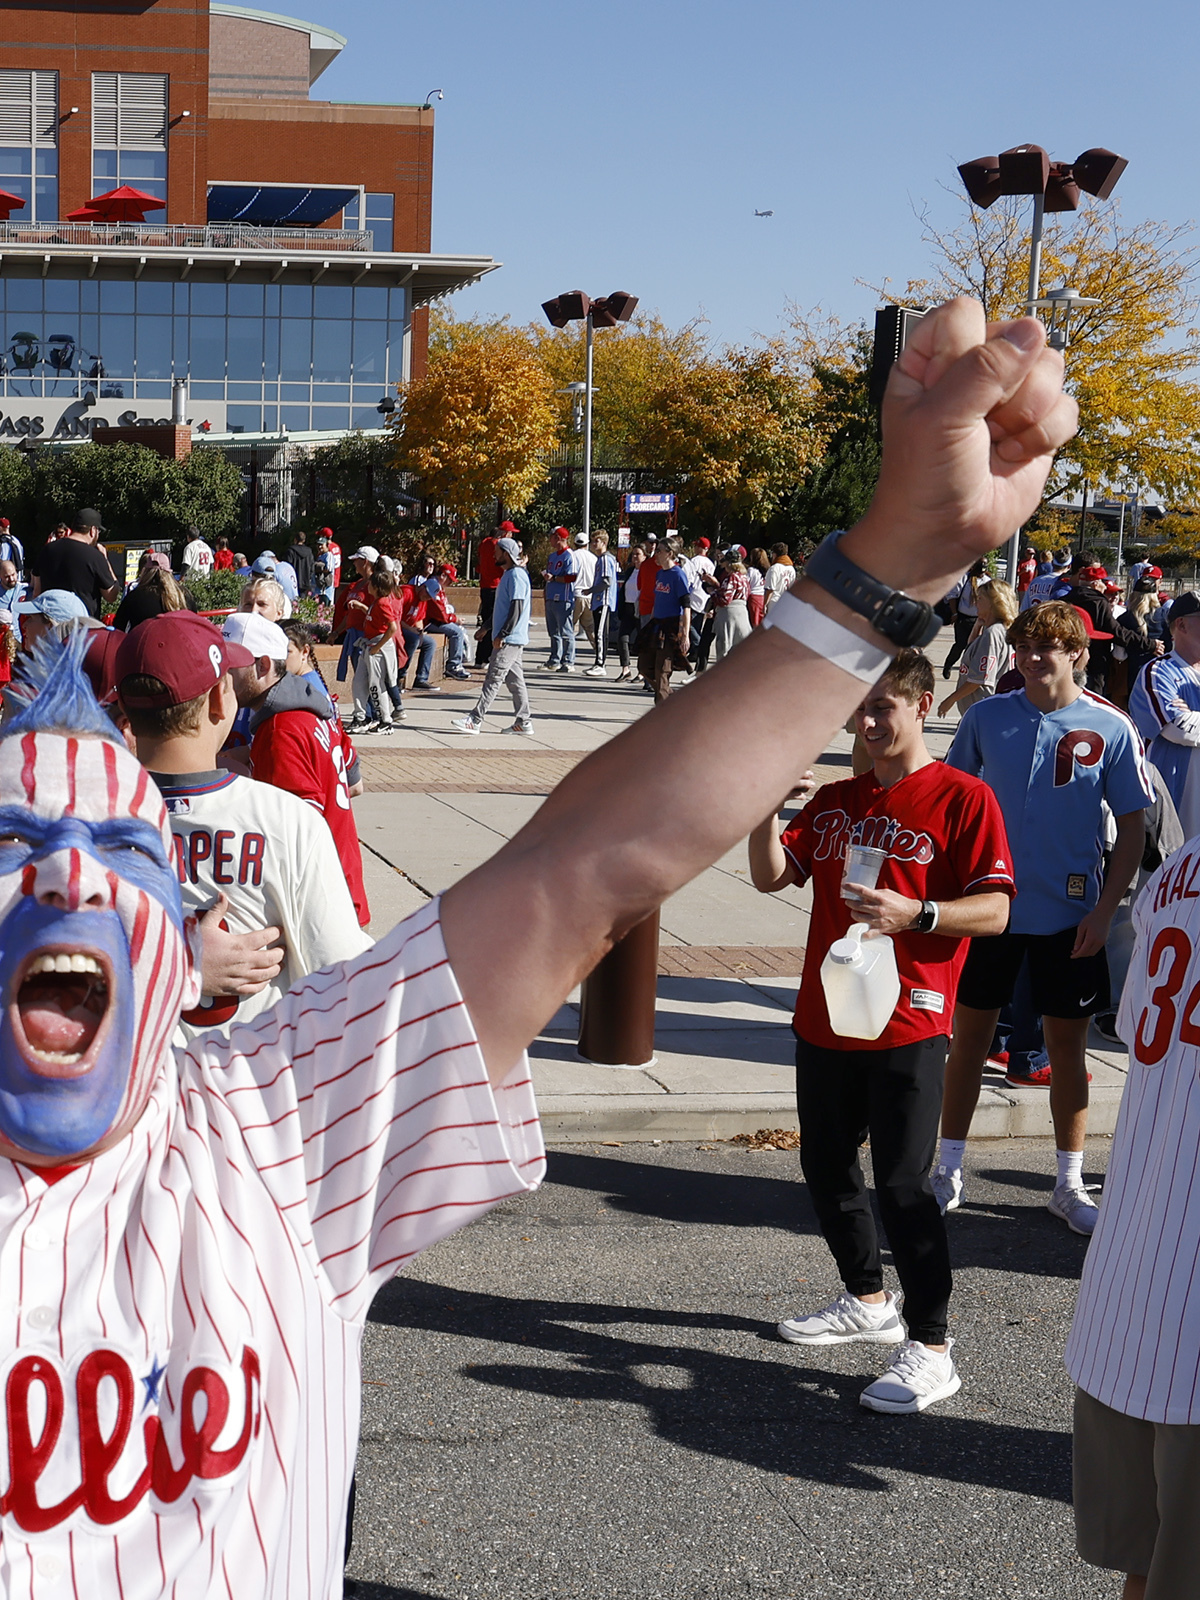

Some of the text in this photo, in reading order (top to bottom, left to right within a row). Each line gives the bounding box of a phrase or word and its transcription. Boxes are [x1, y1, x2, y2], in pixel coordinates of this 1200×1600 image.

[629, 502, 670, 511] SCORECARDS
[208, 644, 223, 679] P
[1053, 728, 1106, 788] P
[813, 808, 935, 865] Phillies
